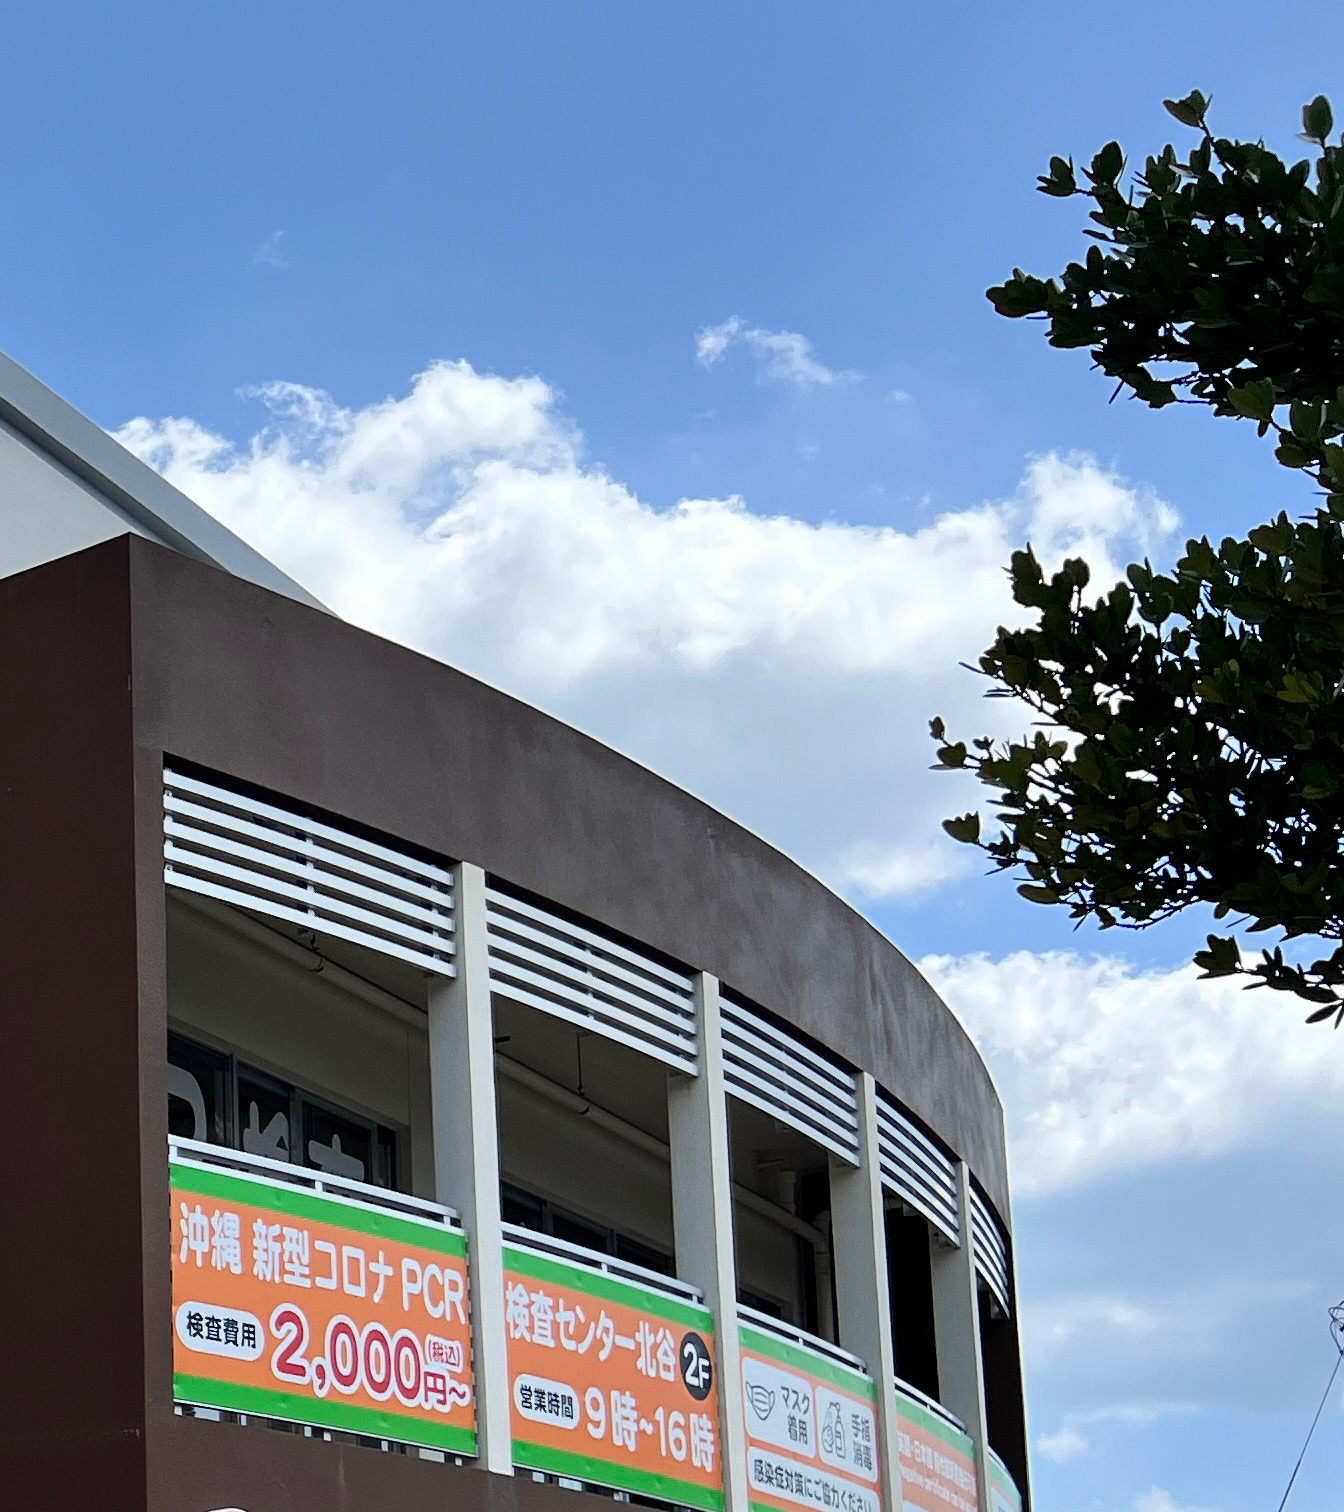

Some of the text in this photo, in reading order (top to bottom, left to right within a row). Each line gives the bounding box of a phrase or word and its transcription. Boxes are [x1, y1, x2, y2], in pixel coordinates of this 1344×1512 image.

[180, 1201, 466, 1324] 沖縄 新型コロナ PCR
[186, 1310, 257, 1349] 検査費用
[506, 1281, 676, 1382] 検査センター北谷
[683, 1342, 710, 1388] 2F
[520, 1384, 574, 1420] 営業時間
[781, 1385, 810, 1414] マスク
[787, 1416, 808, 1445] 着用
